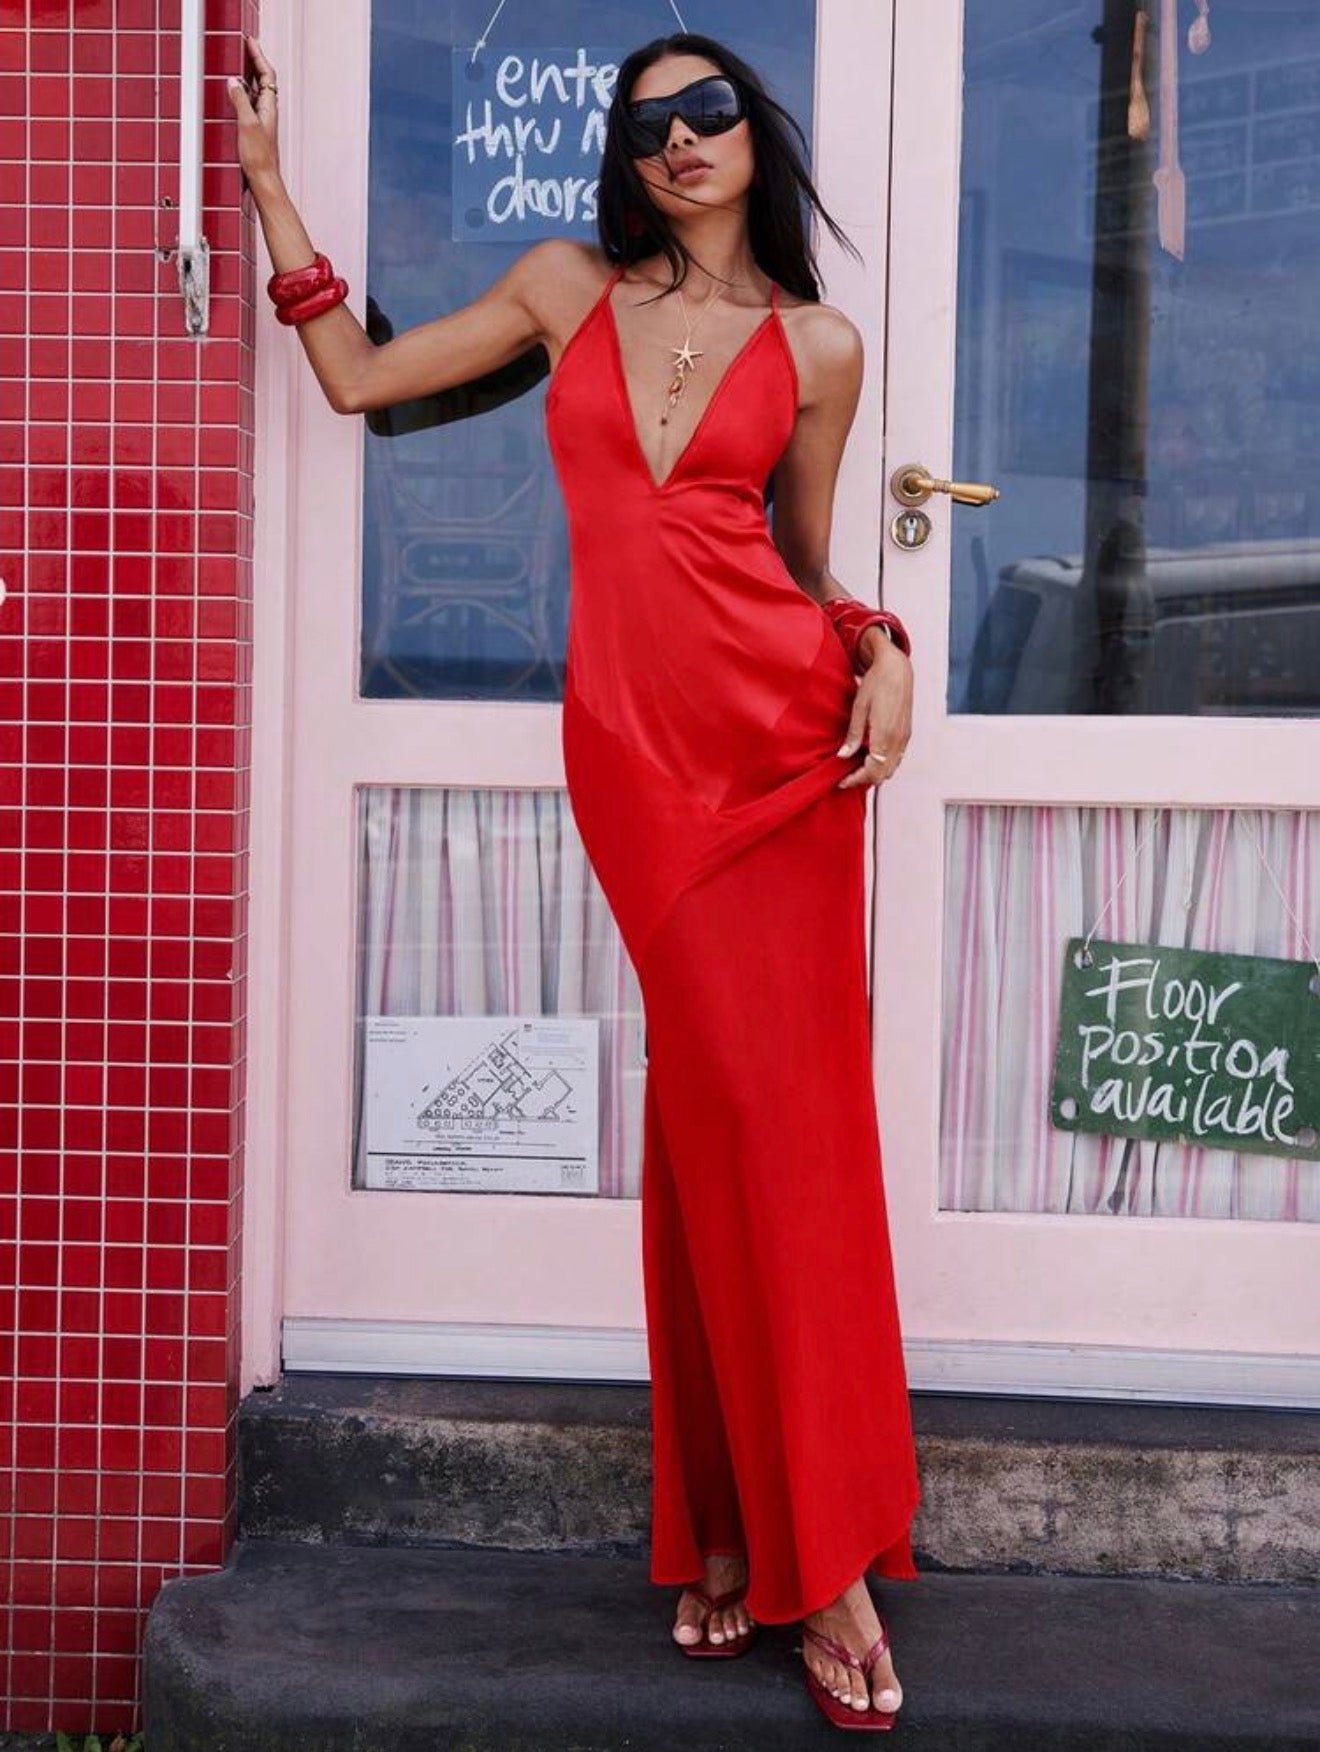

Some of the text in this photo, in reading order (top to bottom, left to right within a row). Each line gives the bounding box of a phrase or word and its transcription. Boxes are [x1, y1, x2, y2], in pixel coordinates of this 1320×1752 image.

[496, 48, 620, 108] ente
[455, 99, 561, 164] thru
[487, 153, 599, 224] doors
[1086, 957, 1242, 1024] Floor
[1078, 1023, 1294, 1091] position
[1090, 1074, 1296, 1145] available
